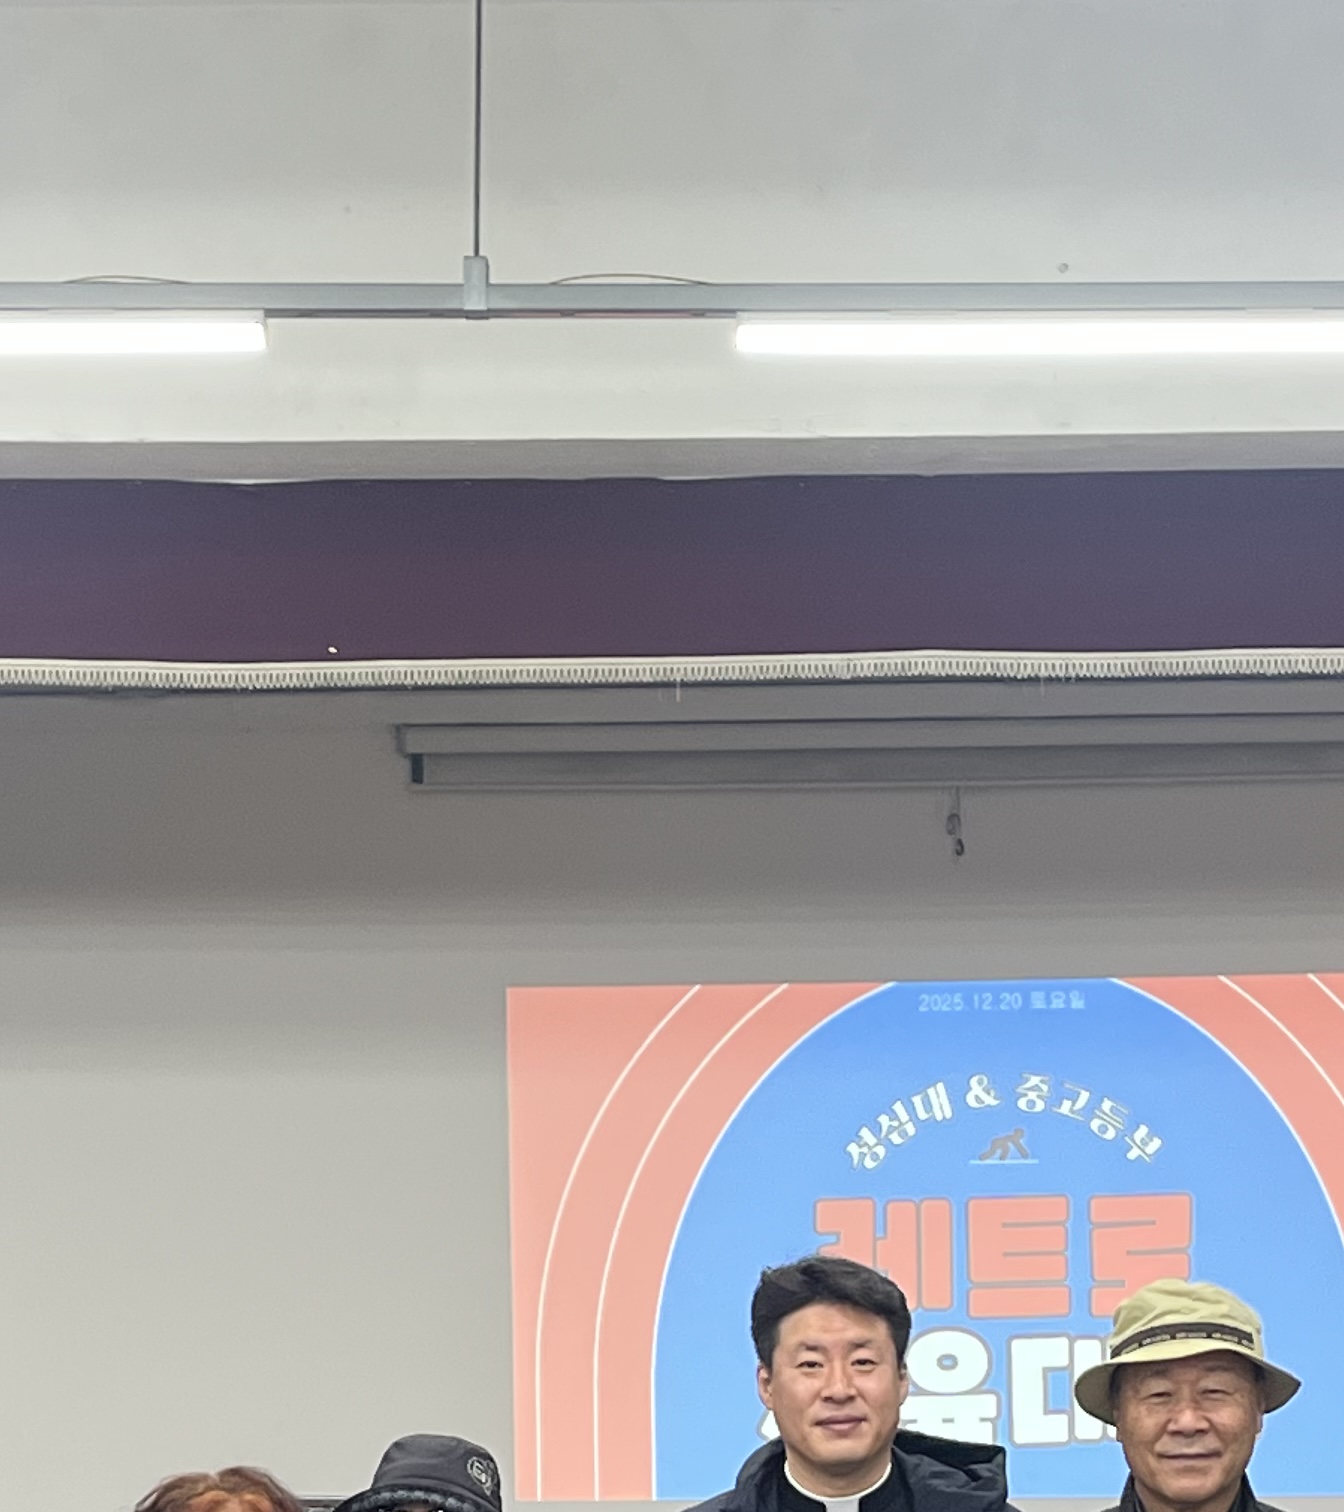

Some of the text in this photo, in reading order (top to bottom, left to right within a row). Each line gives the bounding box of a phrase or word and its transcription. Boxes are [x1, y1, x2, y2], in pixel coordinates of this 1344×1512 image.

[917, 990, 1087, 1012] 2025.12.20 토요일
[844, 1072, 1164, 1171] 성심대 & 중고등부
